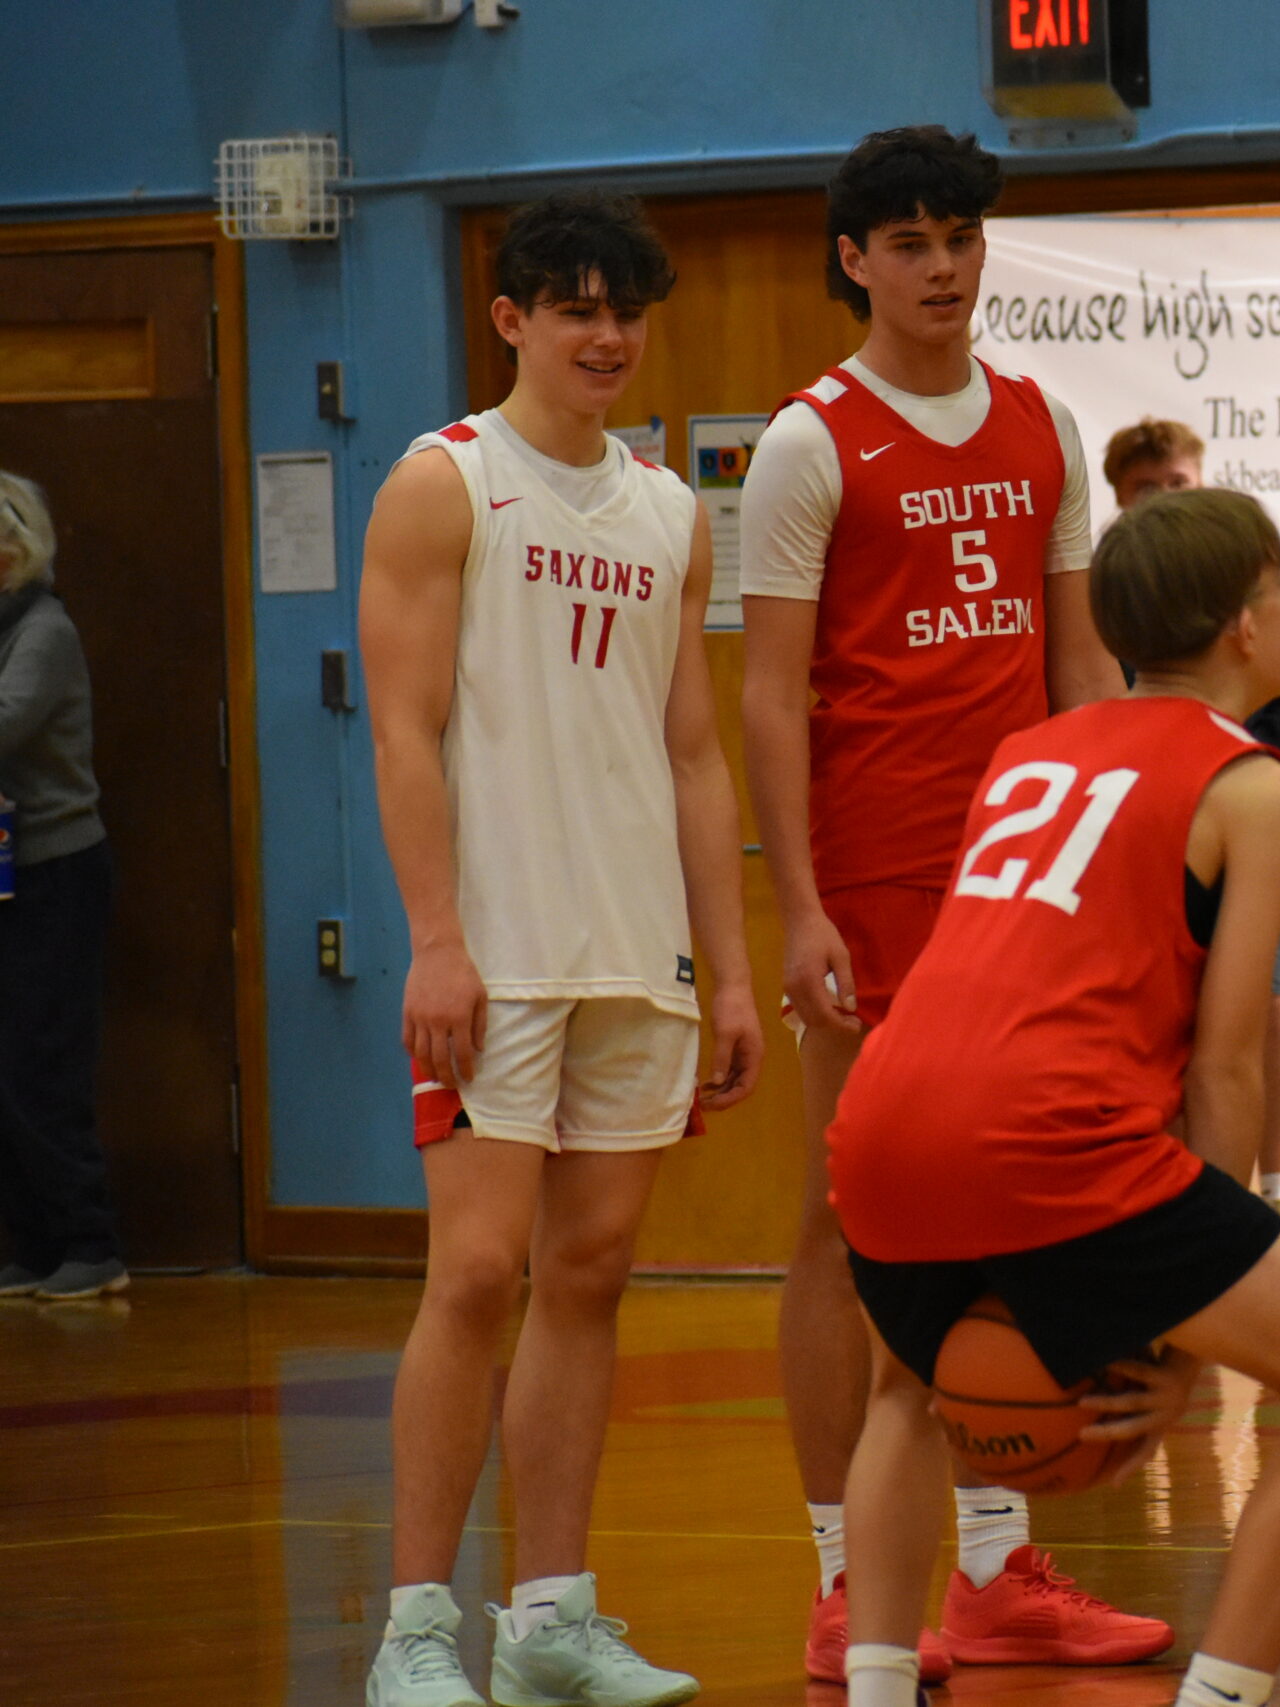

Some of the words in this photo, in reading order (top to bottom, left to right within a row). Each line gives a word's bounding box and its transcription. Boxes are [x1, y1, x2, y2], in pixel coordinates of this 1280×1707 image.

[1140, 268, 1233, 379] high
[1204, 397, 1265, 438] The
[900, 480, 1034, 529] SOUTH
[525, 545, 654, 601] SAXONS
[951, 529, 998, 593] 5
[571, 603, 617, 669] 11
[906, 598, 1034, 647] SALEM
[954, 761, 1140, 916] 21
